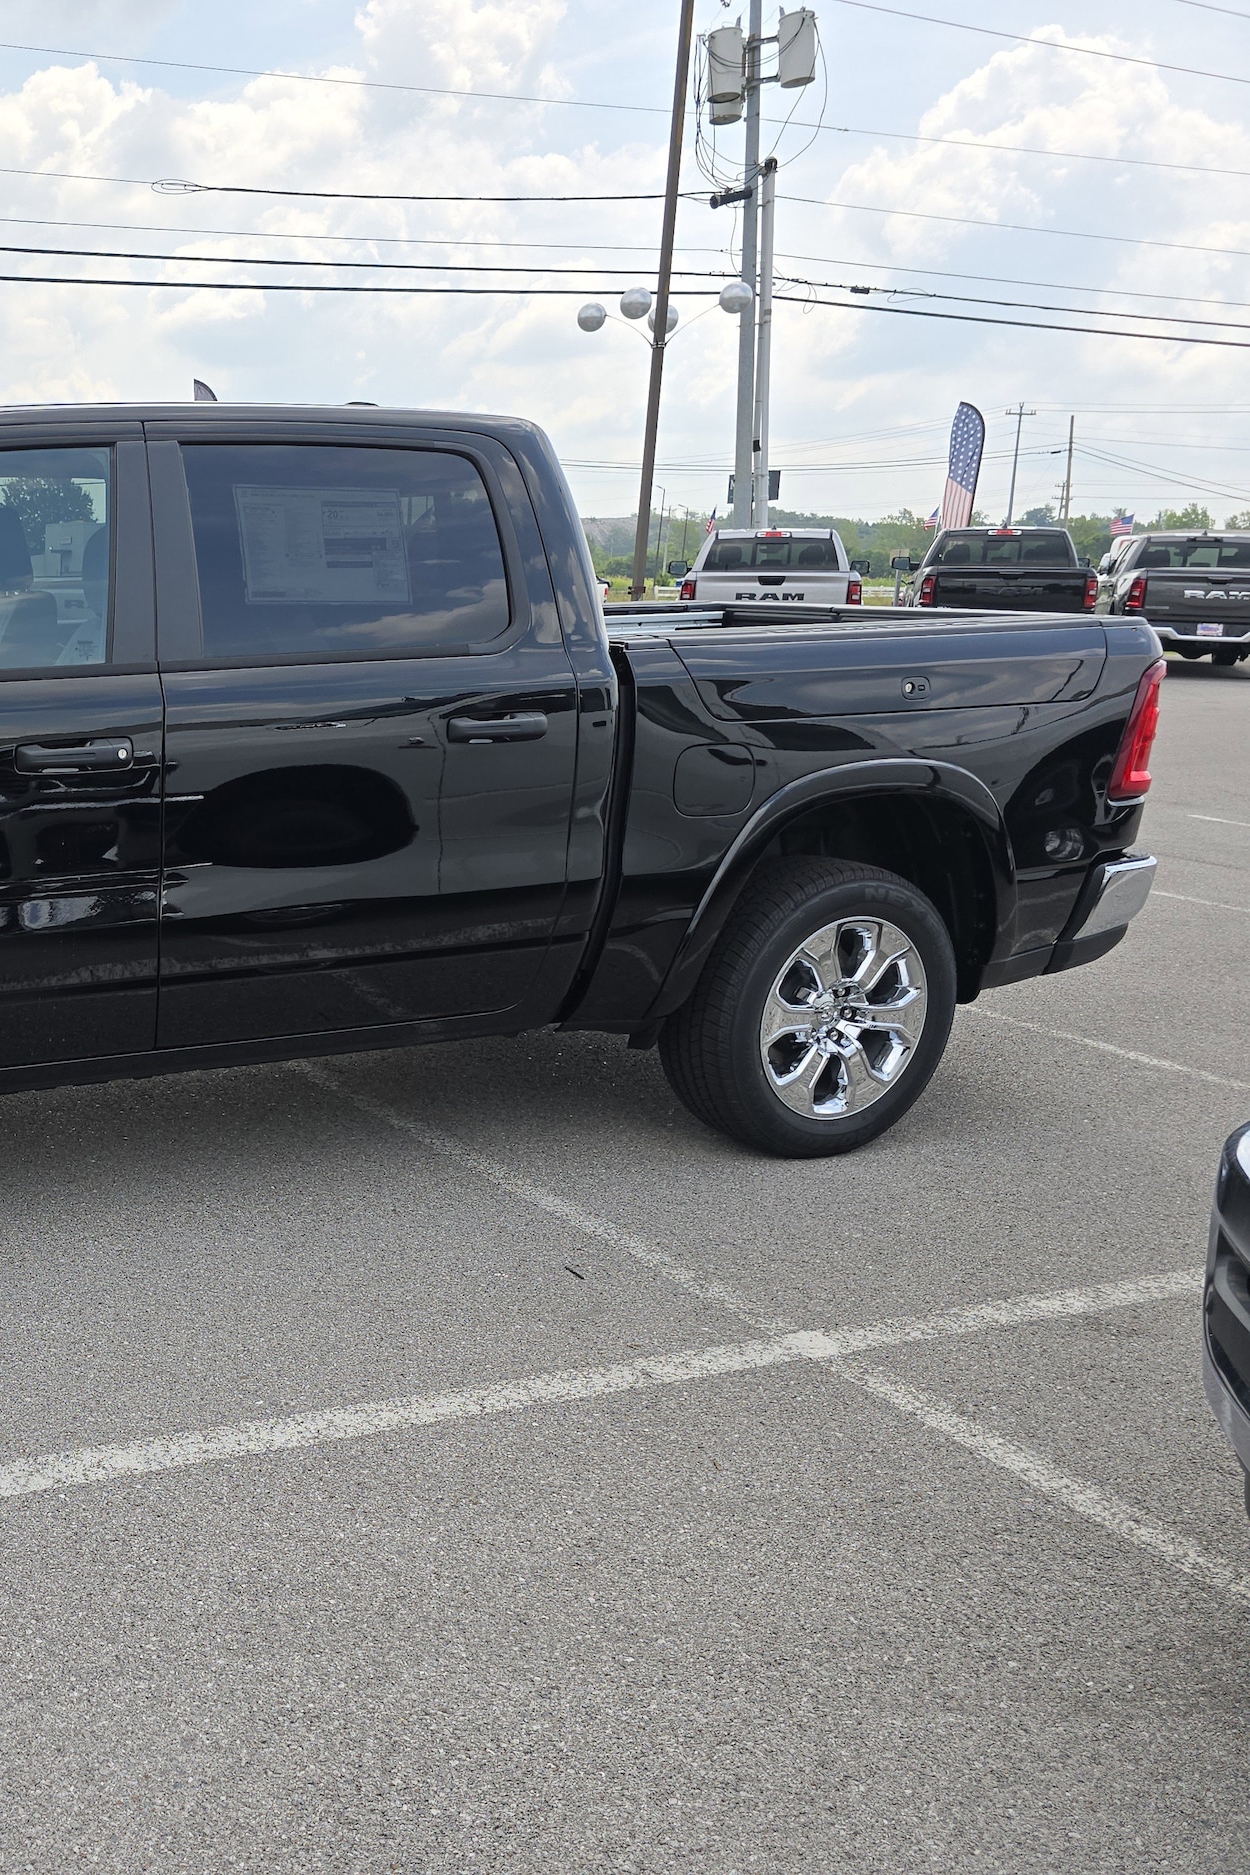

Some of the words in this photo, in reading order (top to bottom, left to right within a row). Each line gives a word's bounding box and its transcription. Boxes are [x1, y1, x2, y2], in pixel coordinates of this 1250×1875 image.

[735, 592, 805, 601] RAM
[975, 586, 1044, 597] RAM
[1184, 589, 1250, 600] RAM
